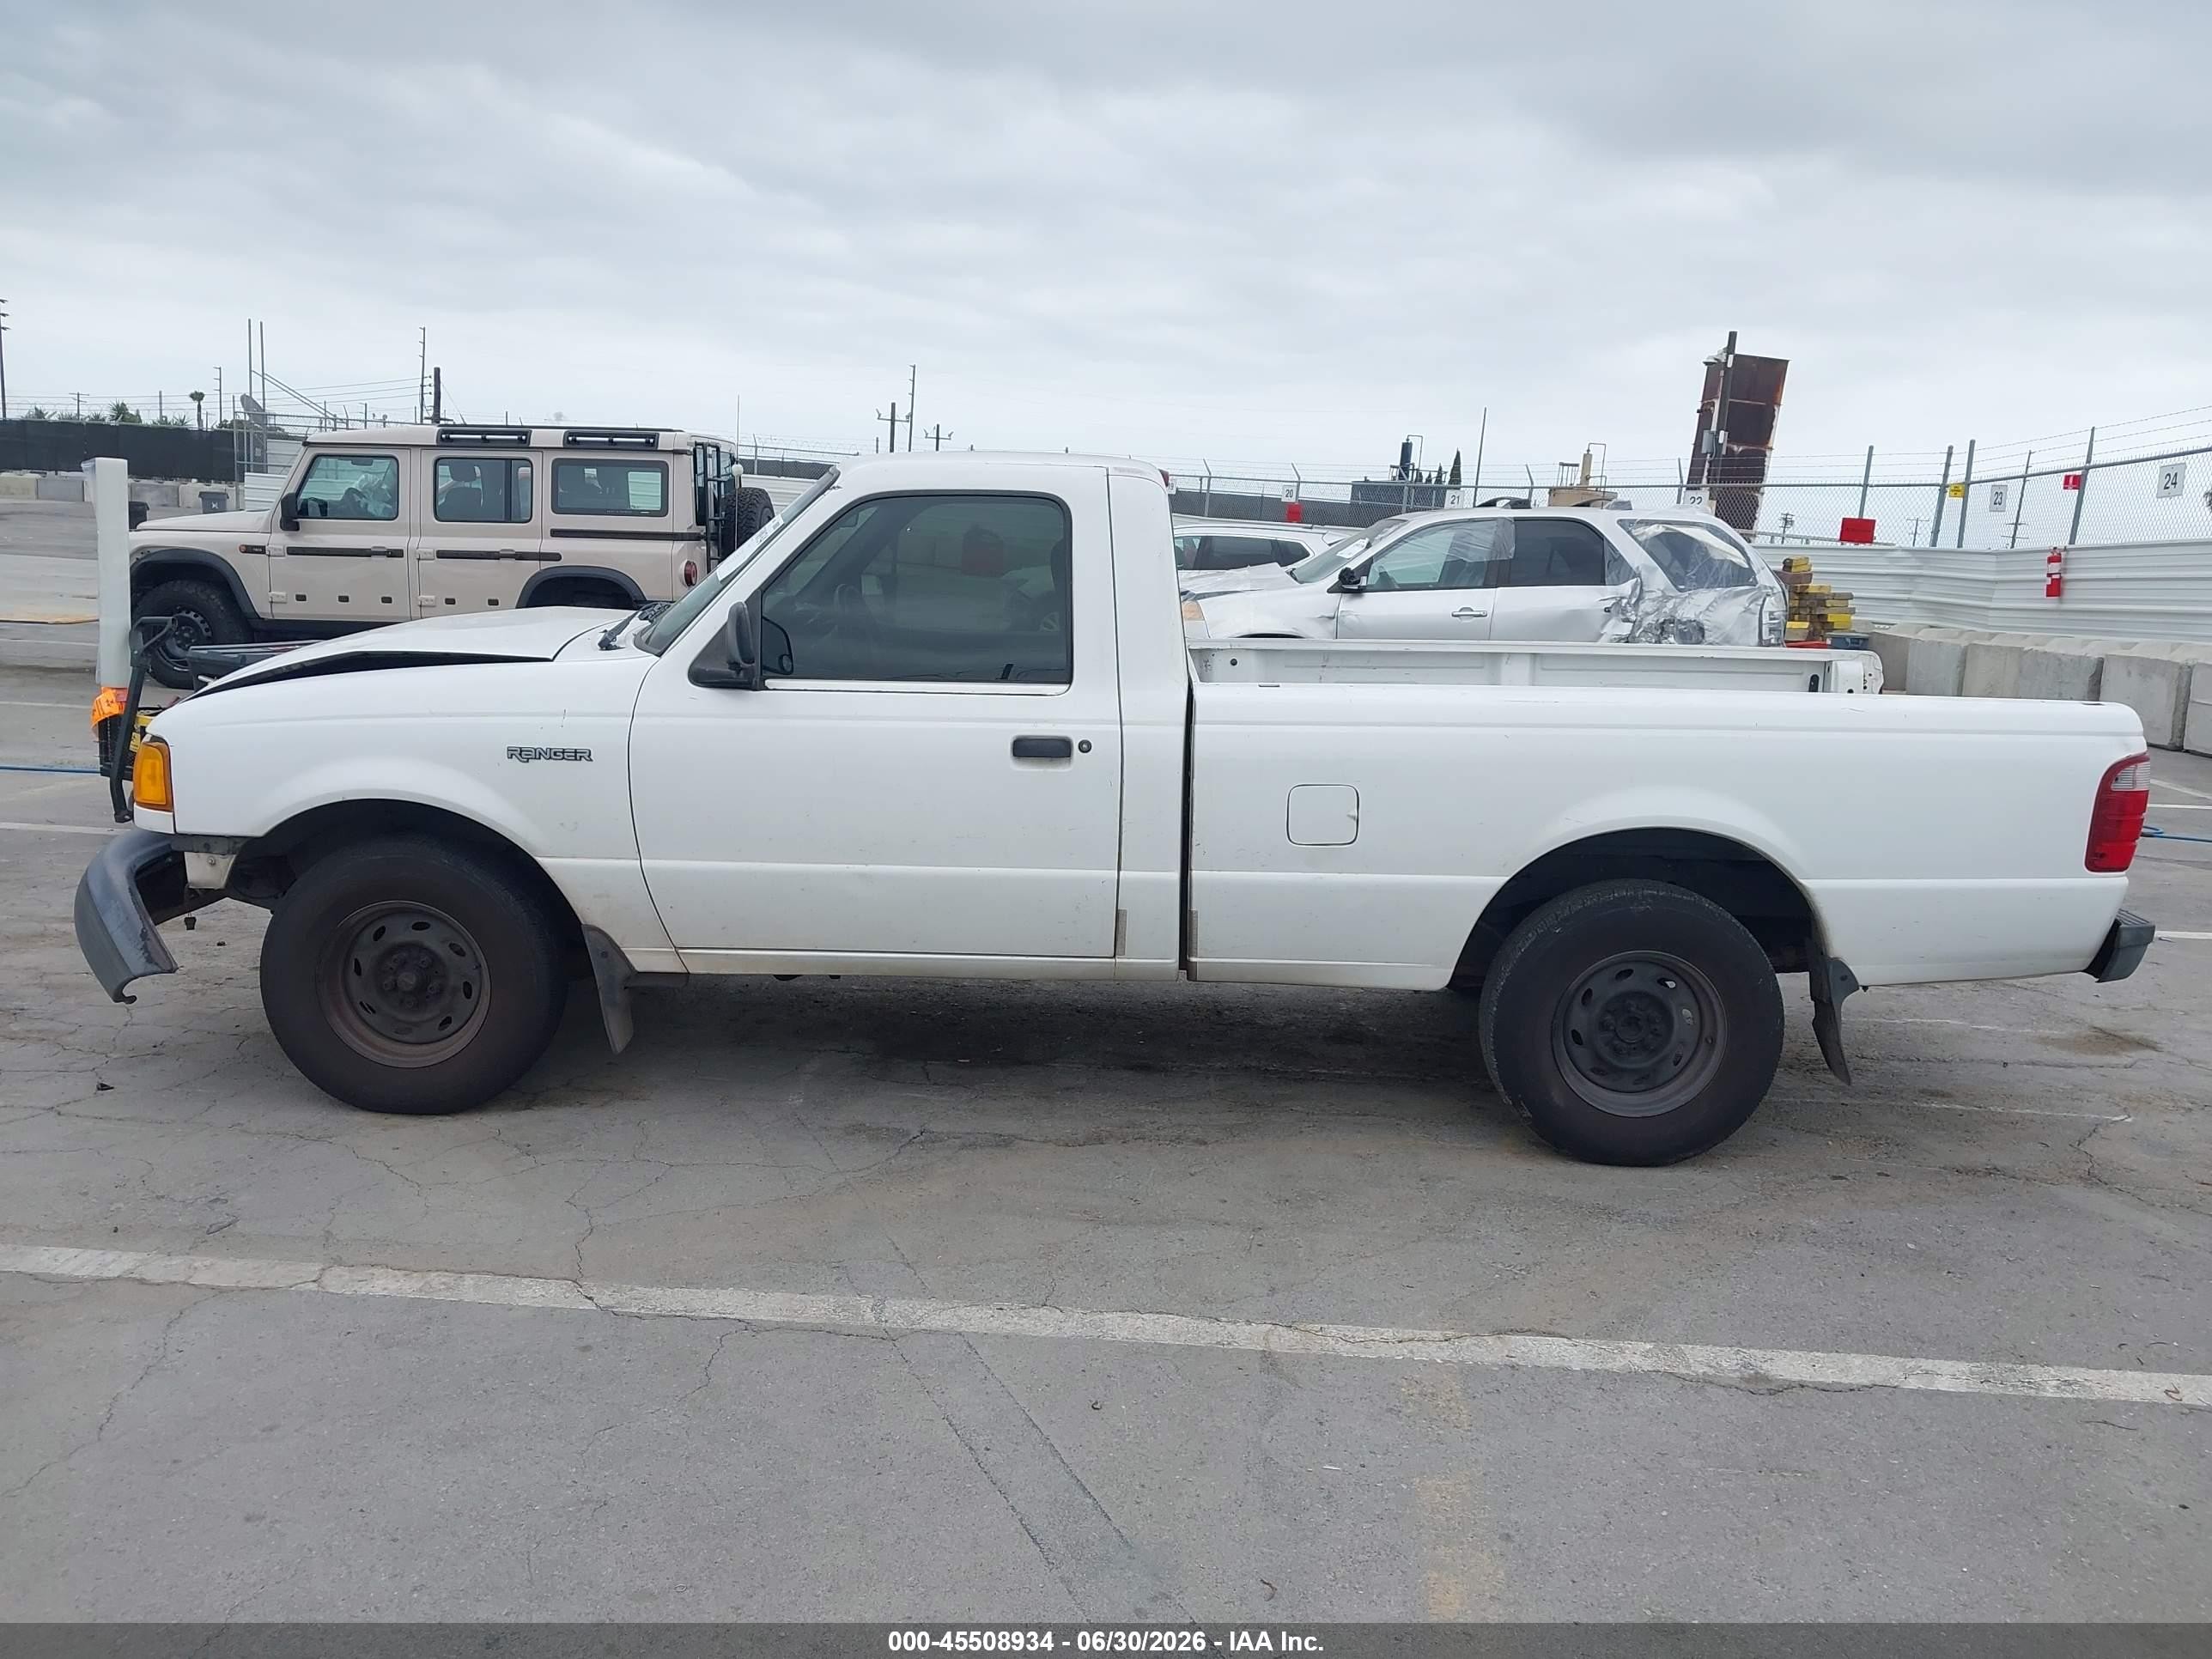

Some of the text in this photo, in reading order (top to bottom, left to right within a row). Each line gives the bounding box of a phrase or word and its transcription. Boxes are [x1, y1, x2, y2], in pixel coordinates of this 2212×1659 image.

[2163, 471, 2178, 490] 24
[1285, 489, 1293, 498] 20
[1450, 495, 1460, 504] 21
[1994, 491, 2003, 506] 23
[507, 746, 593, 763] RANGER
